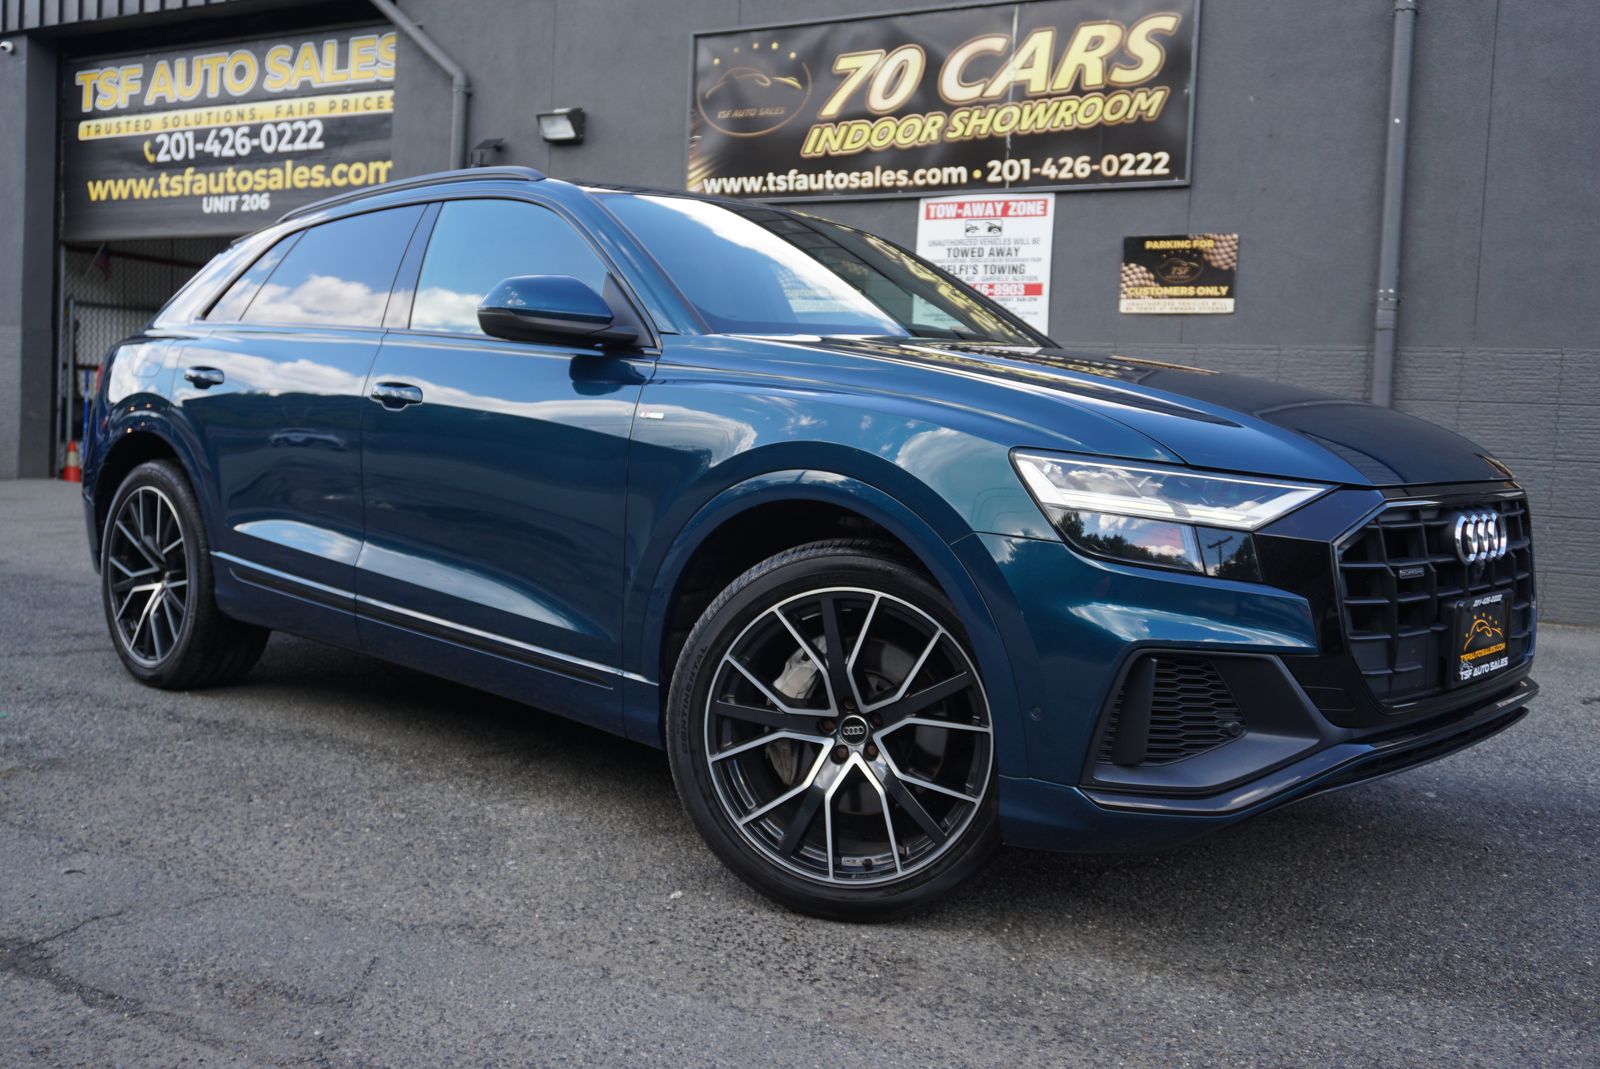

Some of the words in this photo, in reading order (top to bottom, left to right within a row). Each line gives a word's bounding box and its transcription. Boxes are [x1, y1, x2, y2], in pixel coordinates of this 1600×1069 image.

[76, 63, 144, 113] TSF
[144, 49, 259, 106] AUTO
[263, 31, 396, 93] SALES
[818, 41, 926, 119] 70
[938, 13, 1182, 104] CARS
[84, 118, 153, 136] TRUSTED
[162, 108, 264, 130] SOLUTIONS,
[275, 101, 317, 118] FAIR
[731, 107, 758, 118] AUTO
[758, 106, 785, 116] SALES
[800, 110, 943, 159] INDOOR
[945, 86, 1171, 141] SHOWROOM
[156, 119, 325, 163] 201-426-0222
[703, 164, 968, 195] www.tsfautosales.com
[986, 152, 1170, 183] 201-426-0222
[202, 195, 238, 214] UNIT
[240, 193, 271, 212] 206
[928, 201, 1005, 218] TOW-AWAY
[1007, 200, 1045, 216] ZONE
[947, 247, 985, 258] TOWED
[988, 246, 1021, 257] AWAY
[1144, 240, 1192, 250] PARKING
[1193, 239, 1215, 249] FOR
[984, 263, 1026, 275] TOWING
[1127, 286, 1196, 296] CUSTOMERS
[1196, 285, 1229, 296] ONLY
[1459, 669, 1473, 681] TSF
[1473, 663, 1490, 677] AUTO
[1490, 656, 1509, 672] SALES
